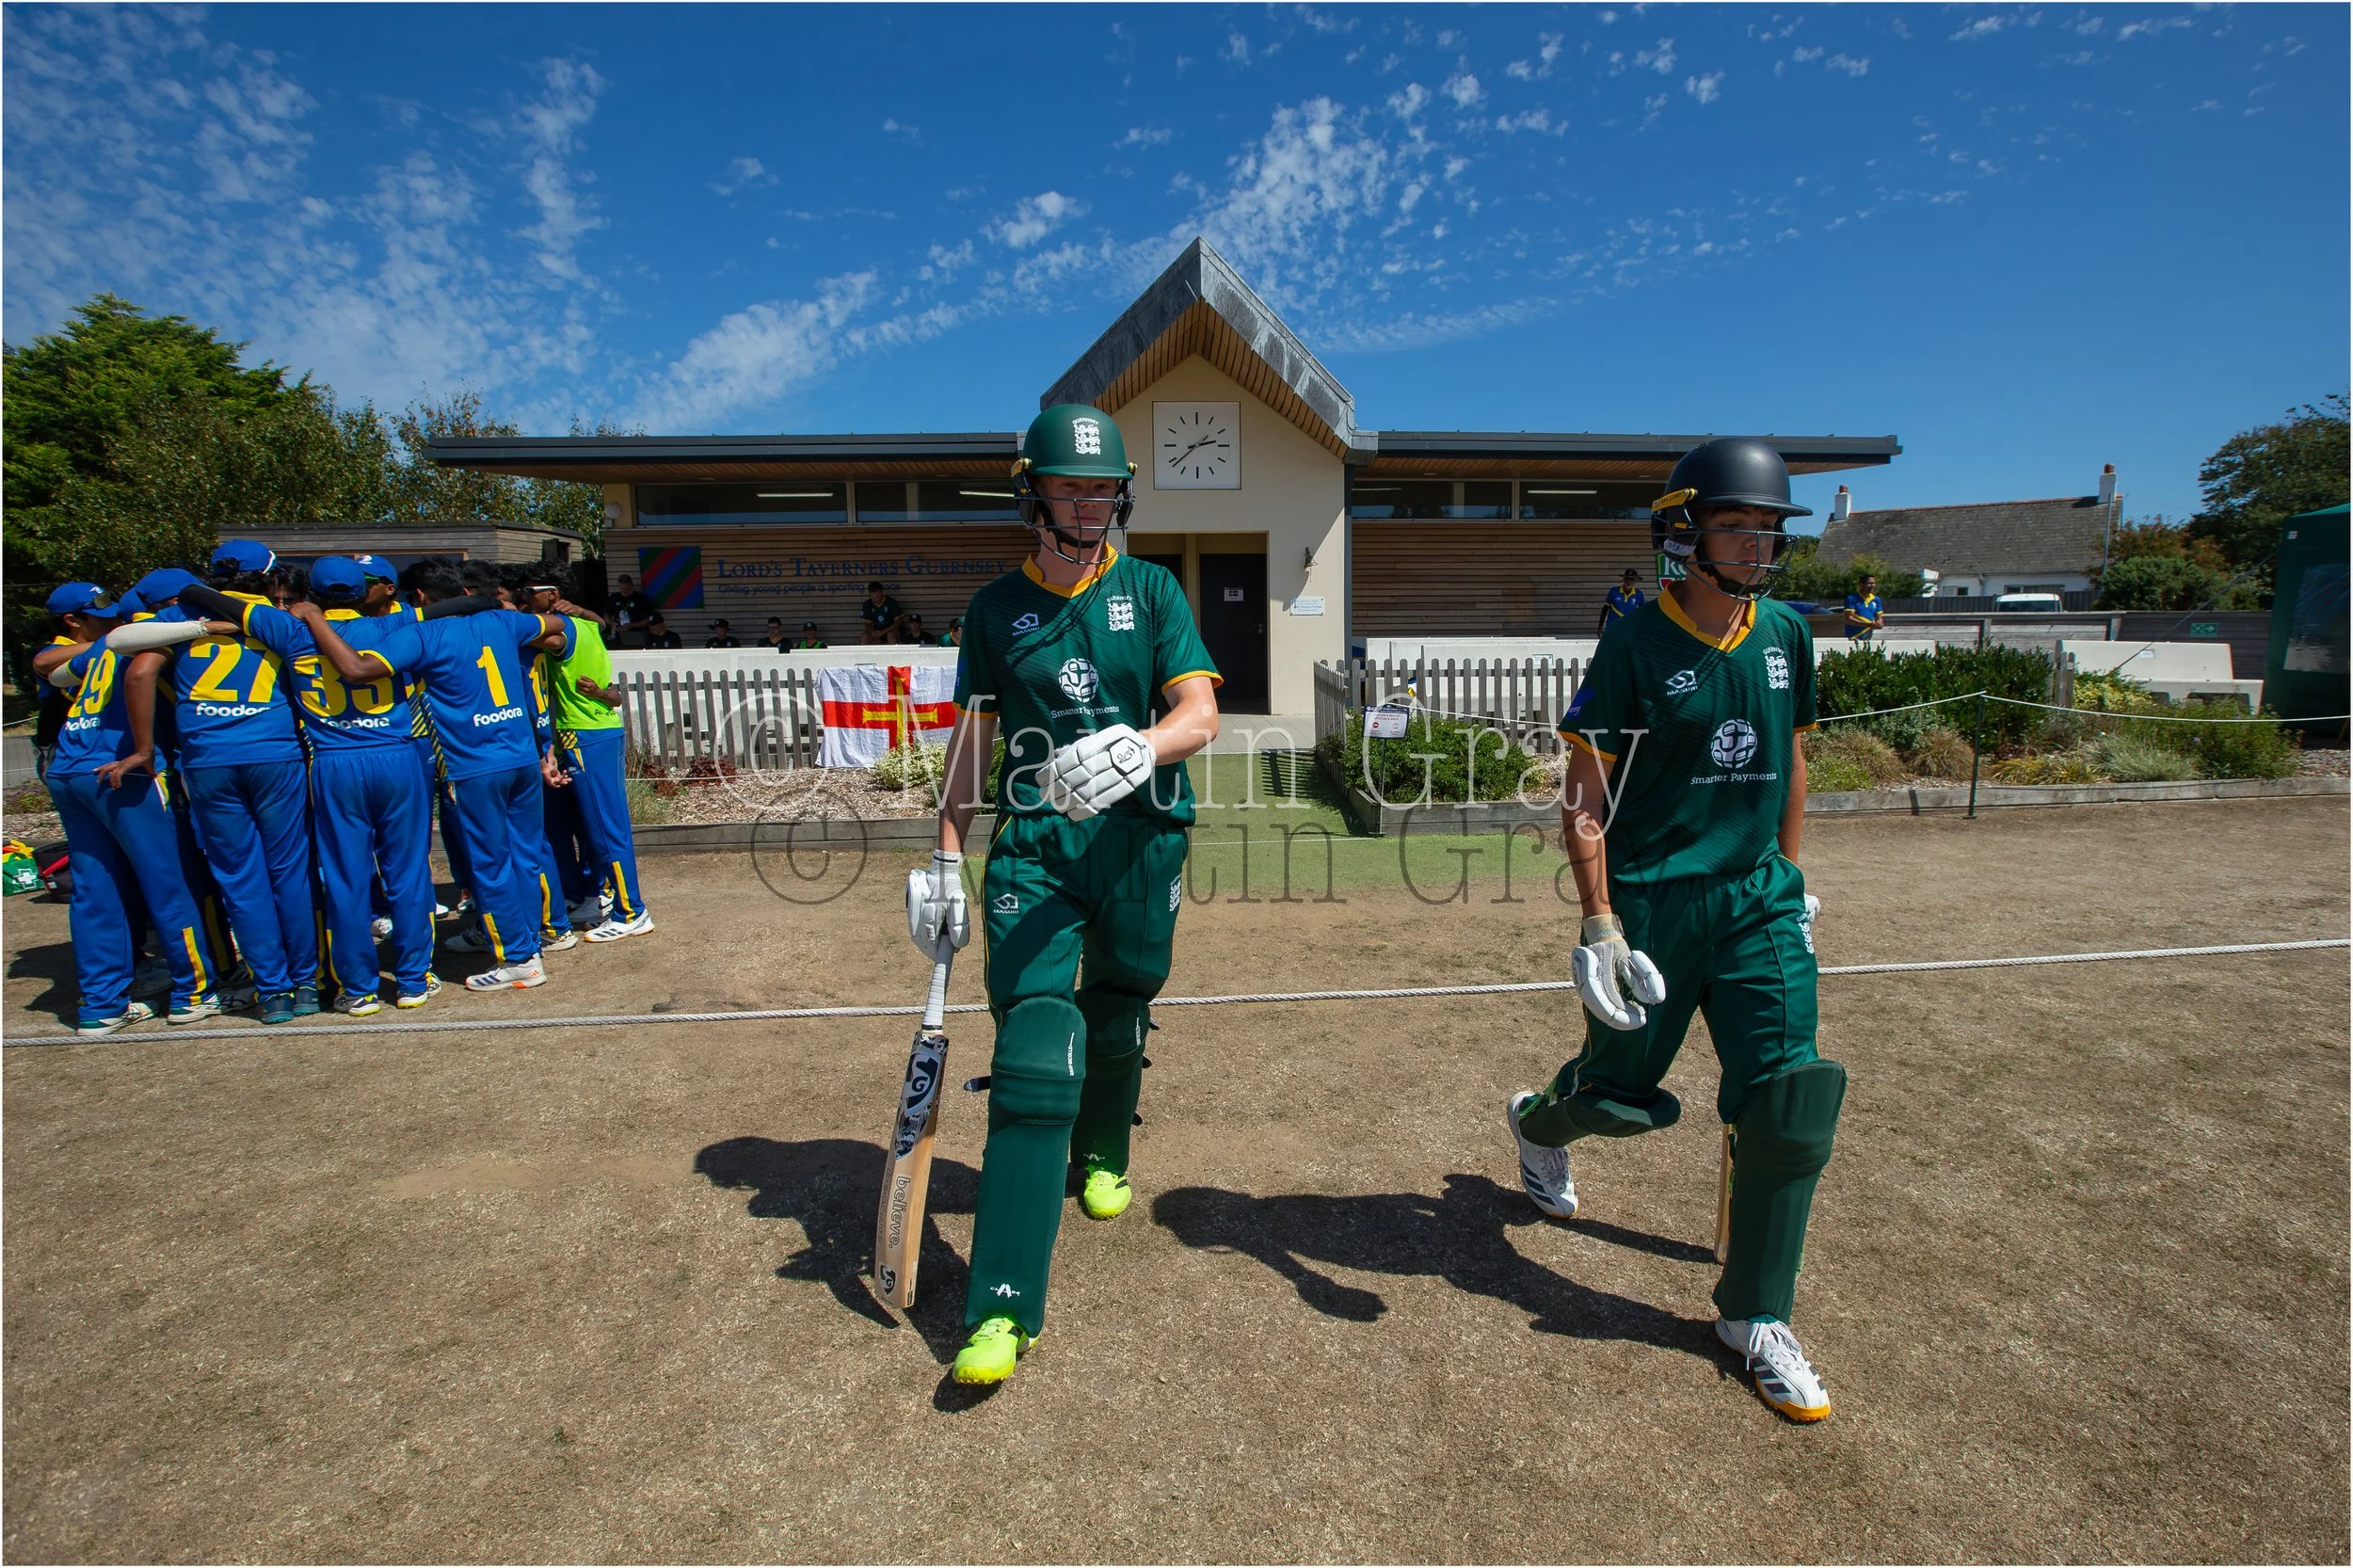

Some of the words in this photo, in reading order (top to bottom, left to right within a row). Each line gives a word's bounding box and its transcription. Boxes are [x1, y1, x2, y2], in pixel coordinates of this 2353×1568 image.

[717, 559, 782, 578] LORD'S
[790, 557, 899, 577] TAVERNERS
[904, 555, 1007, 574] GUERNSEY
[718, 584, 749, 595] Giving
[753, 584, 780, 595] young
[784, 584, 816, 595] people
[828, 582, 864, 594] sporting
[189, 634, 282, 703] 27
[476, 646, 509, 708] 1
[196, 702, 271, 717] foodo
[1690, 772, 1728, 785] Smarter
[1730, 770, 1777, 783] Payments
[888, 1176, 911, 1249] believe.
